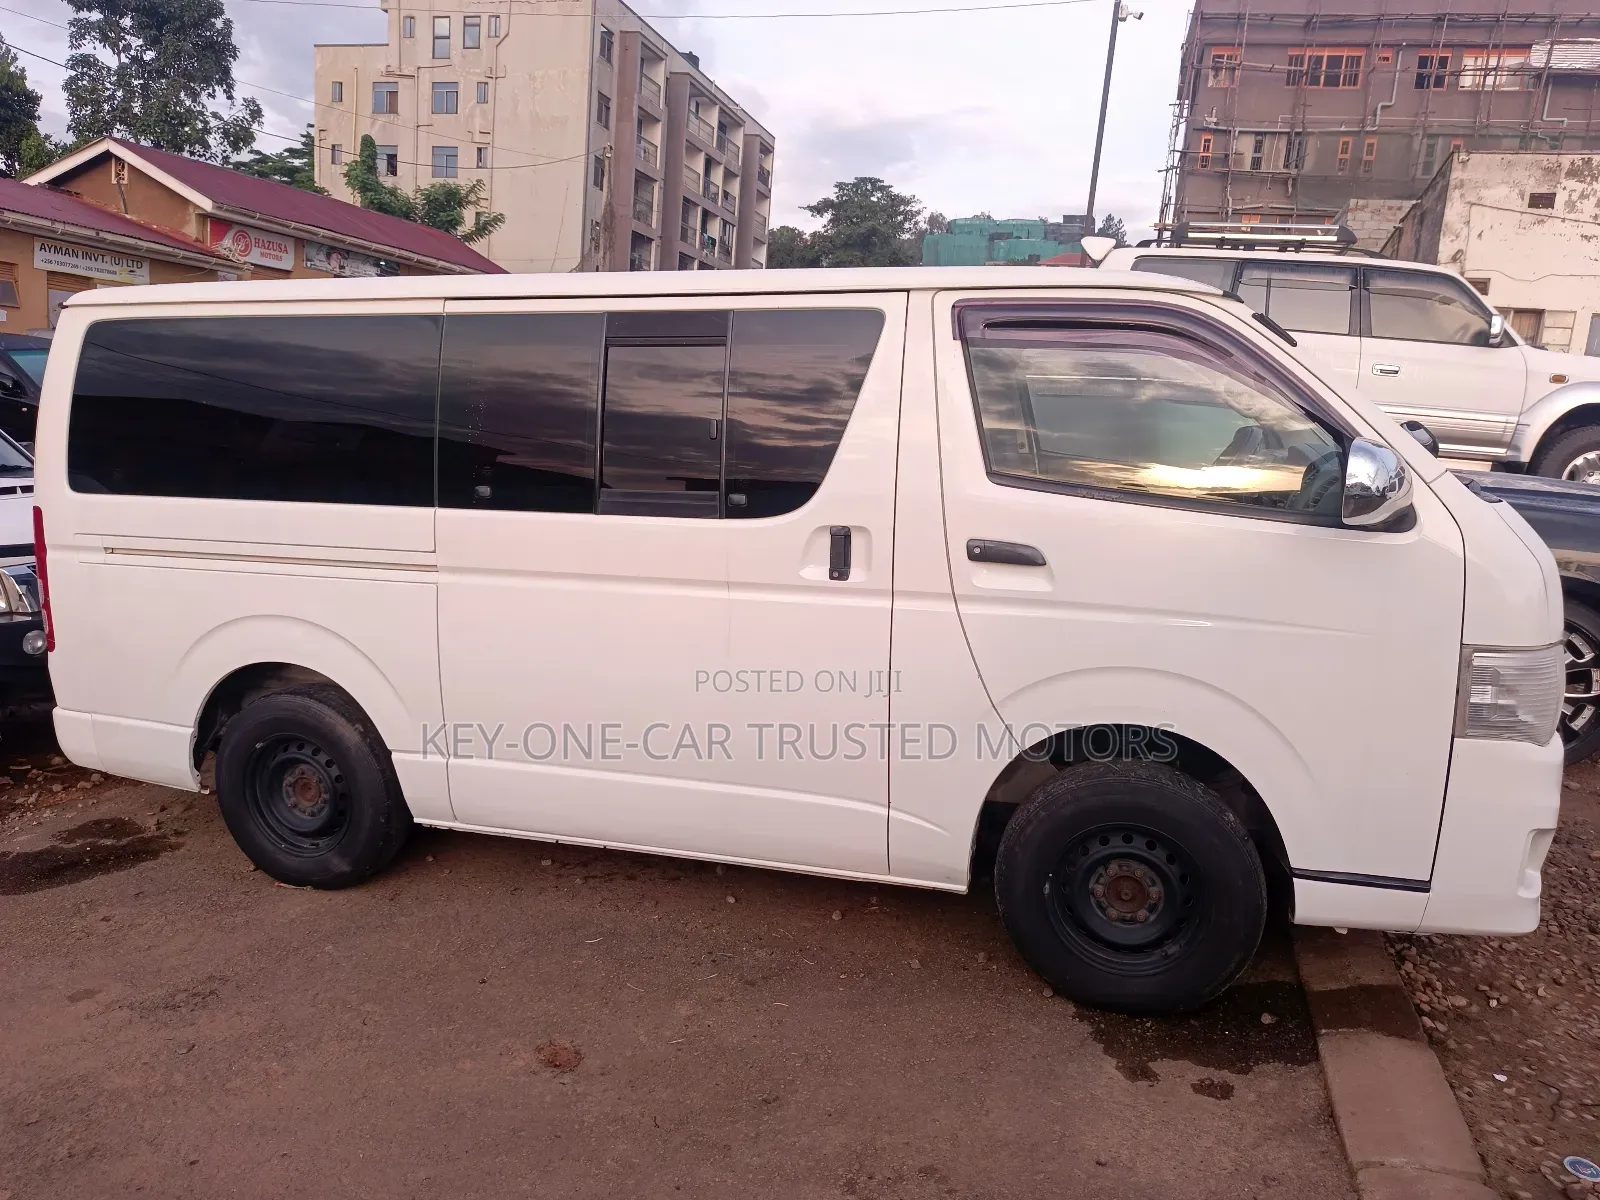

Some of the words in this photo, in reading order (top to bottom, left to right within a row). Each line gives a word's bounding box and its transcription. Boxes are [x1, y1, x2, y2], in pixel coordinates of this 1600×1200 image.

[254, 237, 289, 254] HAZUSA
[39, 242, 79, 259] AYMAN
[81, 250, 108, 264] INVT.
[110, 255, 124, 268] (U)
[126, 259, 143, 270] LTD
[259, 250, 283, 262] MOTORS
